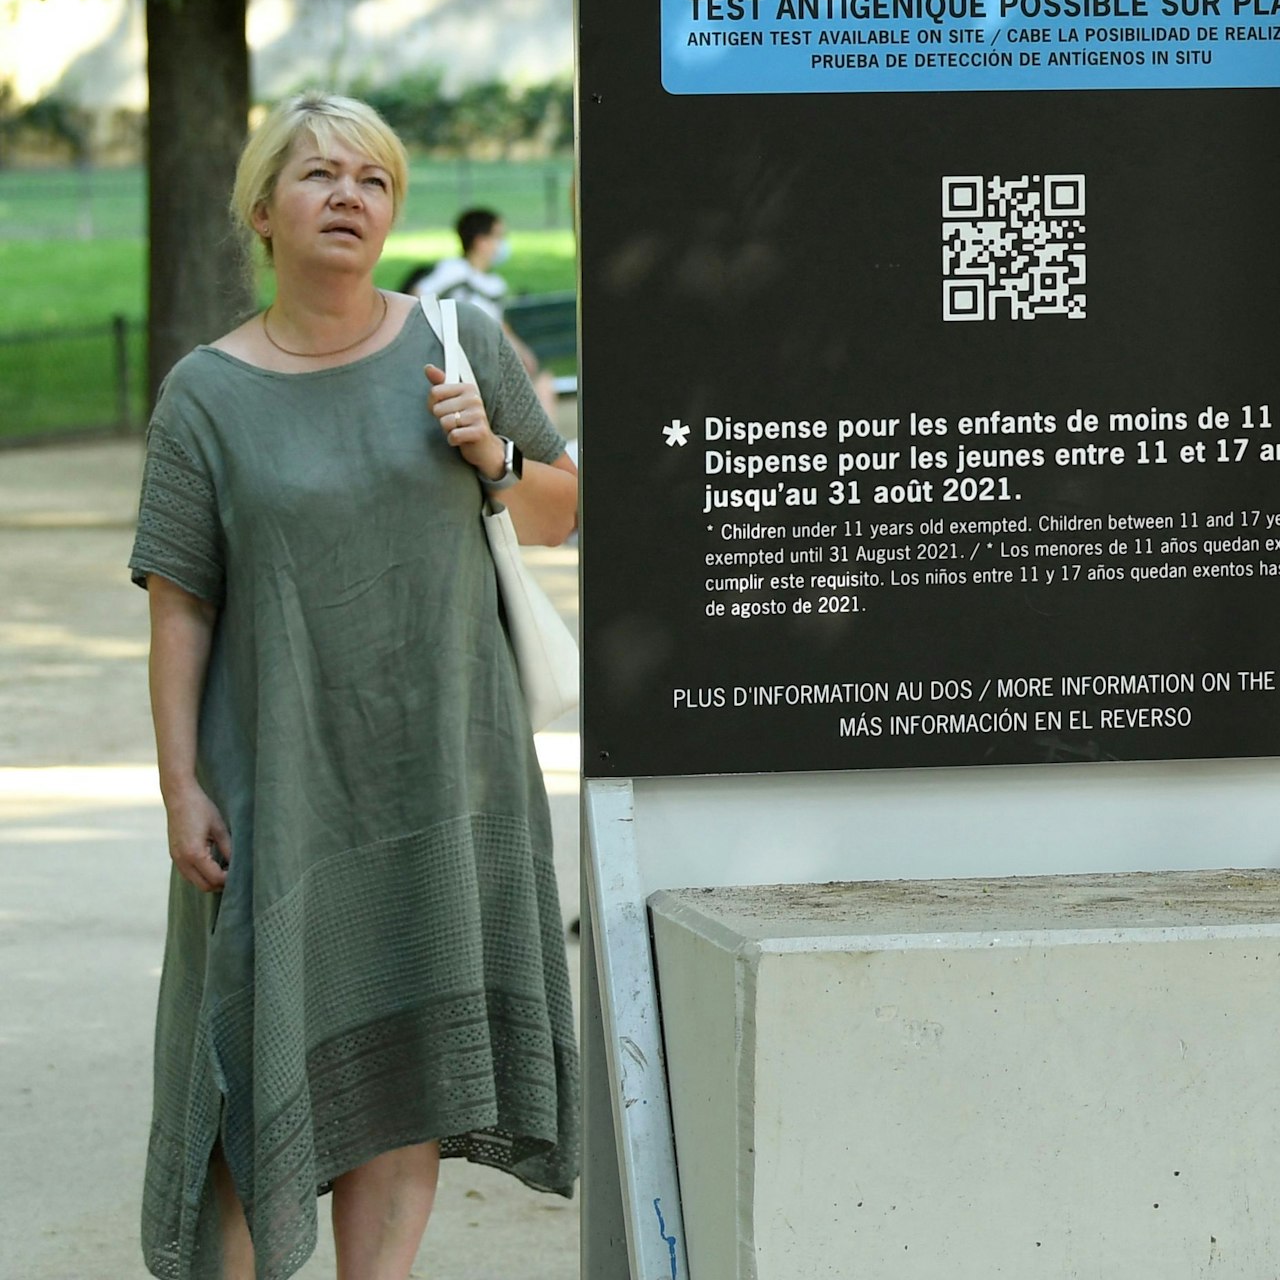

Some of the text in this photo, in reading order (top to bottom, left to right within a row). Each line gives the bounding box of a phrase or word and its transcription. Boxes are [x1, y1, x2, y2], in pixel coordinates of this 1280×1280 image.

[687, 31, 763, 46] ANTIGEN
[769, 31, 812, 45] TEST
[818, 30, 910, 45] AVAILABLE
[917, 29, 941, 44] ON
[949, 29, 985, 44] SITE
[990, 29, 1001, 47] /
[1007, 28, 1052, 43] CABE
[1058, 28, 1079, 42] LA
[1085, 27, 1190, 42] POSIBILIDAD
[1197, 26, 1219, 41] DE
[811, 48, 1212, 69] PRUEBA DE DETECCIÓN DE ANTÍGENOS IN SITU
[705, 417, 827, 445] Dispense
[839, 419, 900, 443] pour
[910, 412, 948, 436] les
[958, 410, 1056, 435] enfants
[1067, 409, 1099, 432] de
[1109, 407, 1188, 431] moins
[1198, 406, 1229, 430] de
[1242, 405, 1272, 428] 11
[705, 450, 828, 478] Dispense
[839, 452, 900, 476] pour
[910, 446, 948, 469] les
[956, 445, 1045, 473] jeunes
[1055, 444, 1125, 466] entre
[1137, 440, 1168, 464] 11
[1180, 441, 1206, 463] et
[1217, 438, 1249, 462] 17
[828, 481, 861, 505] 31
[874, 479, 933, 504] août
[943, 477, 1021, 502] 2021.
[705, 596, 866, 619] de agosto de 2021.
[674, 687, 725, 708] PLUS
[896, 681, 922, 701] AU
[931, 680, 972, 700] DOS
[978, 679, 991, 702] /
[998, 677, 1054, 698] MORE
[1062, 673, 1194, 696] INFORMATION
[1202, 672, 1230, 692] ON
[1237, 671, 1275, 691] THE
[840, 707, 1191, 737] MÁS INFORMACIÓN EN EL REVERSO
